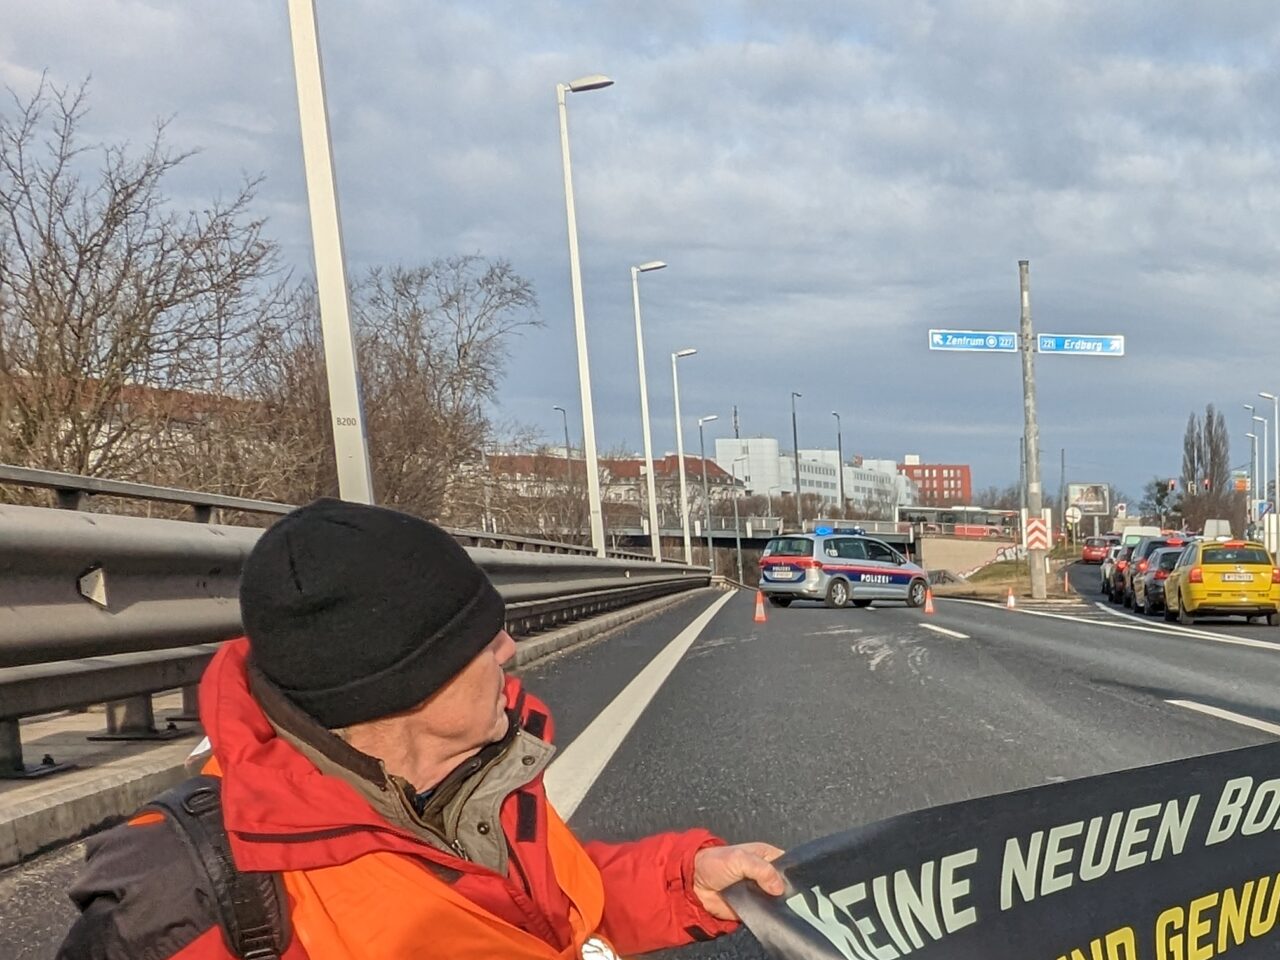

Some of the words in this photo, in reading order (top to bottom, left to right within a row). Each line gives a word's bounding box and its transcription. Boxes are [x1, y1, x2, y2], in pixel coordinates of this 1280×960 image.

[946, 335, 984, 347] Zentrum
[1063, 339, 1103, 351] Erdberg
[860, 574, 889, 584] POLIZEI
[1000, 794, 1200, 911] NEUEN
